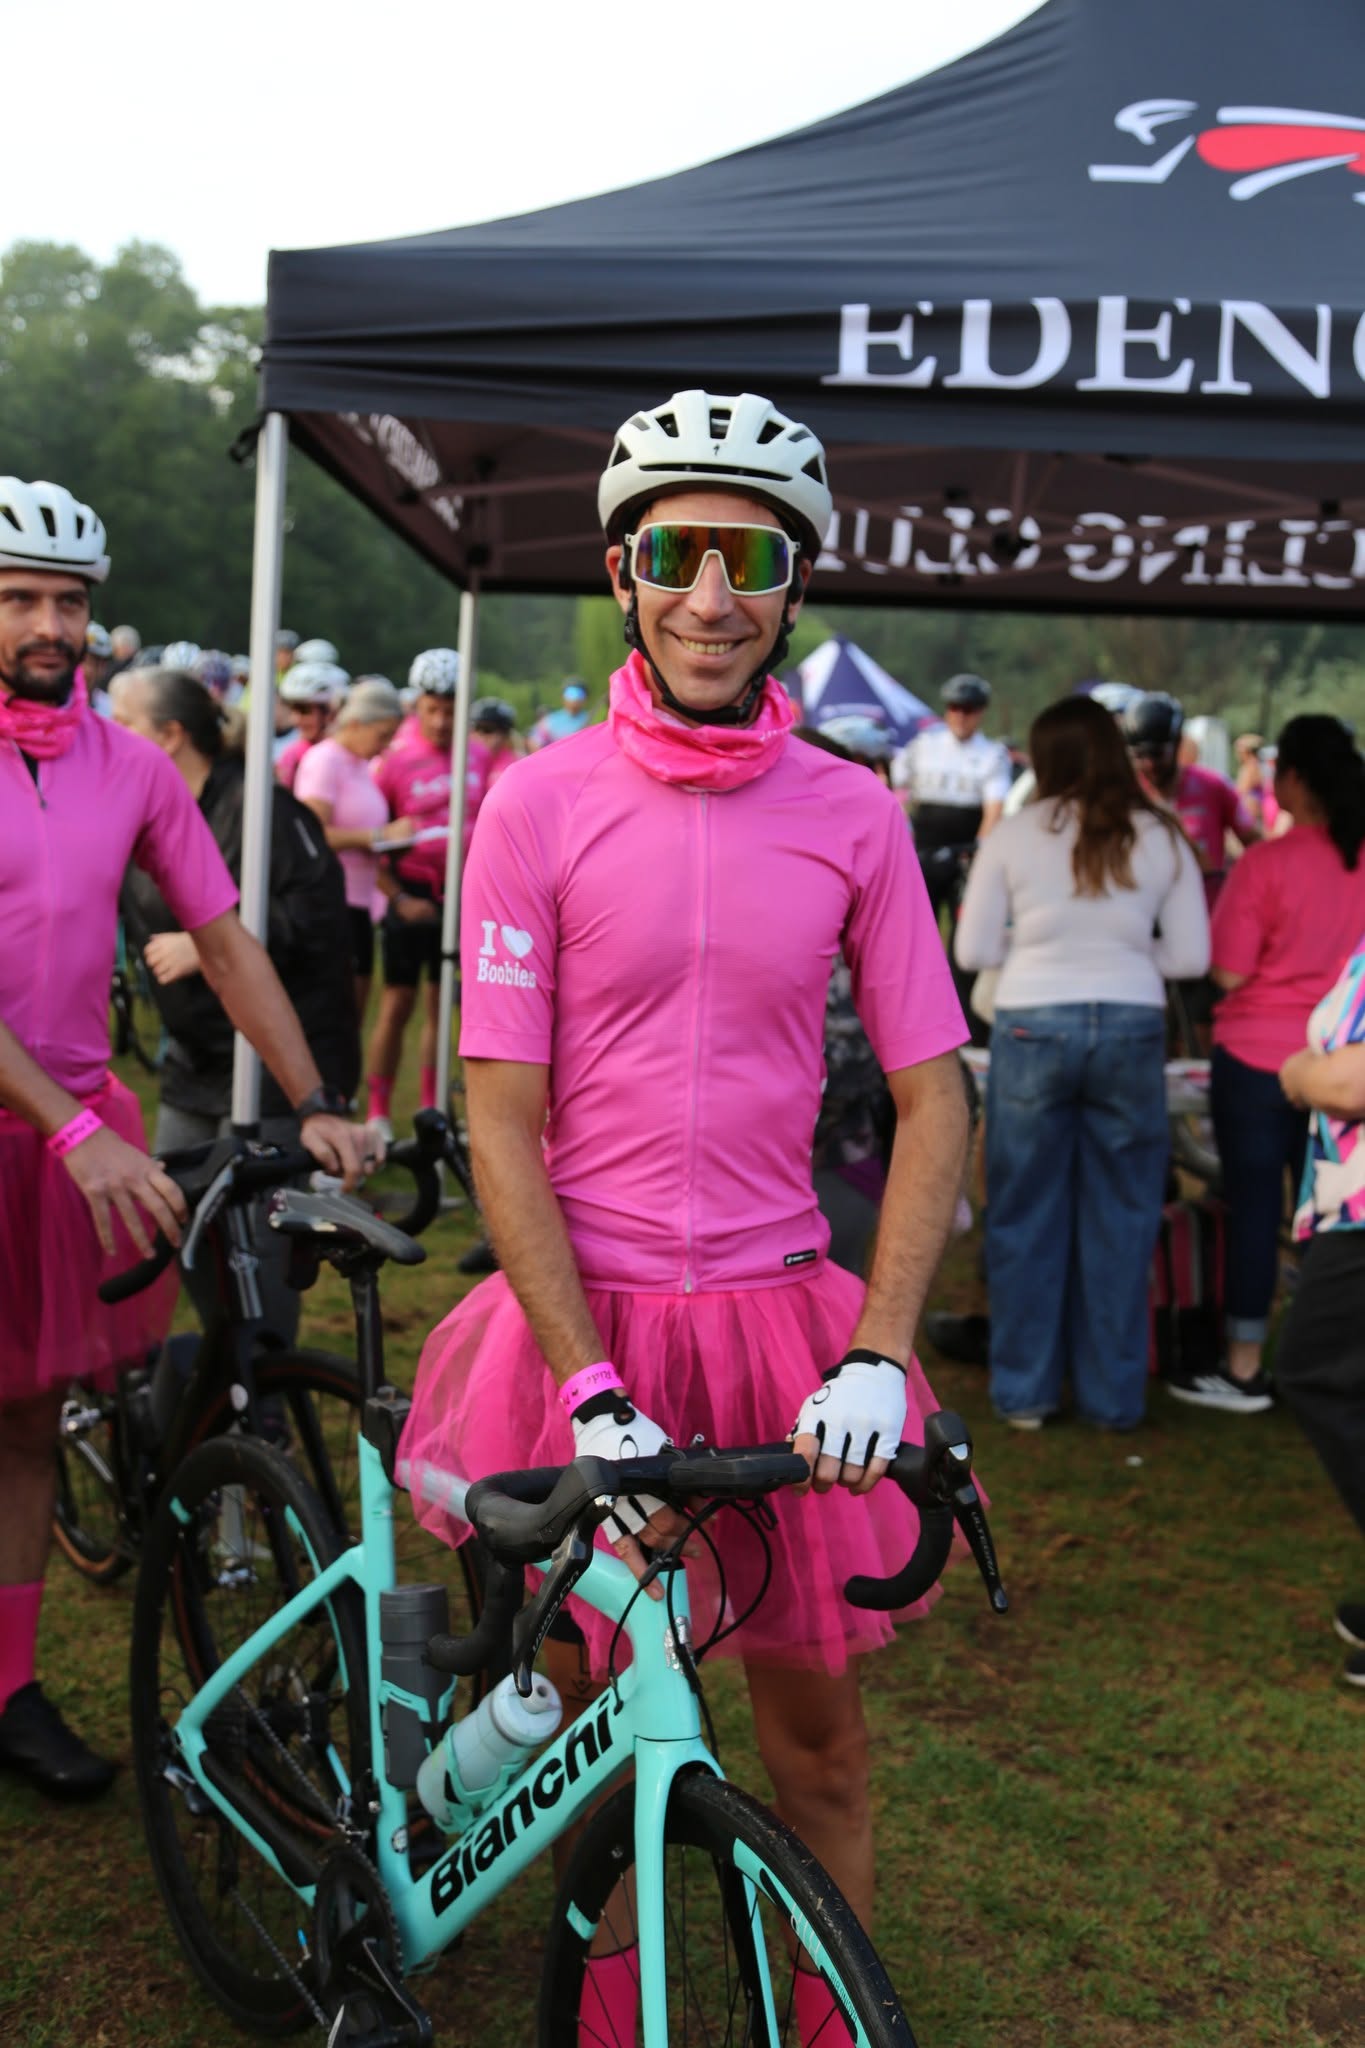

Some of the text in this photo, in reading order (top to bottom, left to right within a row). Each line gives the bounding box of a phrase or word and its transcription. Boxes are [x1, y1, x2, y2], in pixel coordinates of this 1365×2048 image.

[820, 297, 1365, 398] EDEN
[480, 919, 497, 956] I
[477, 957, 537, 988] Boobies
[430, 1694, 614, 1918] Bianchi
